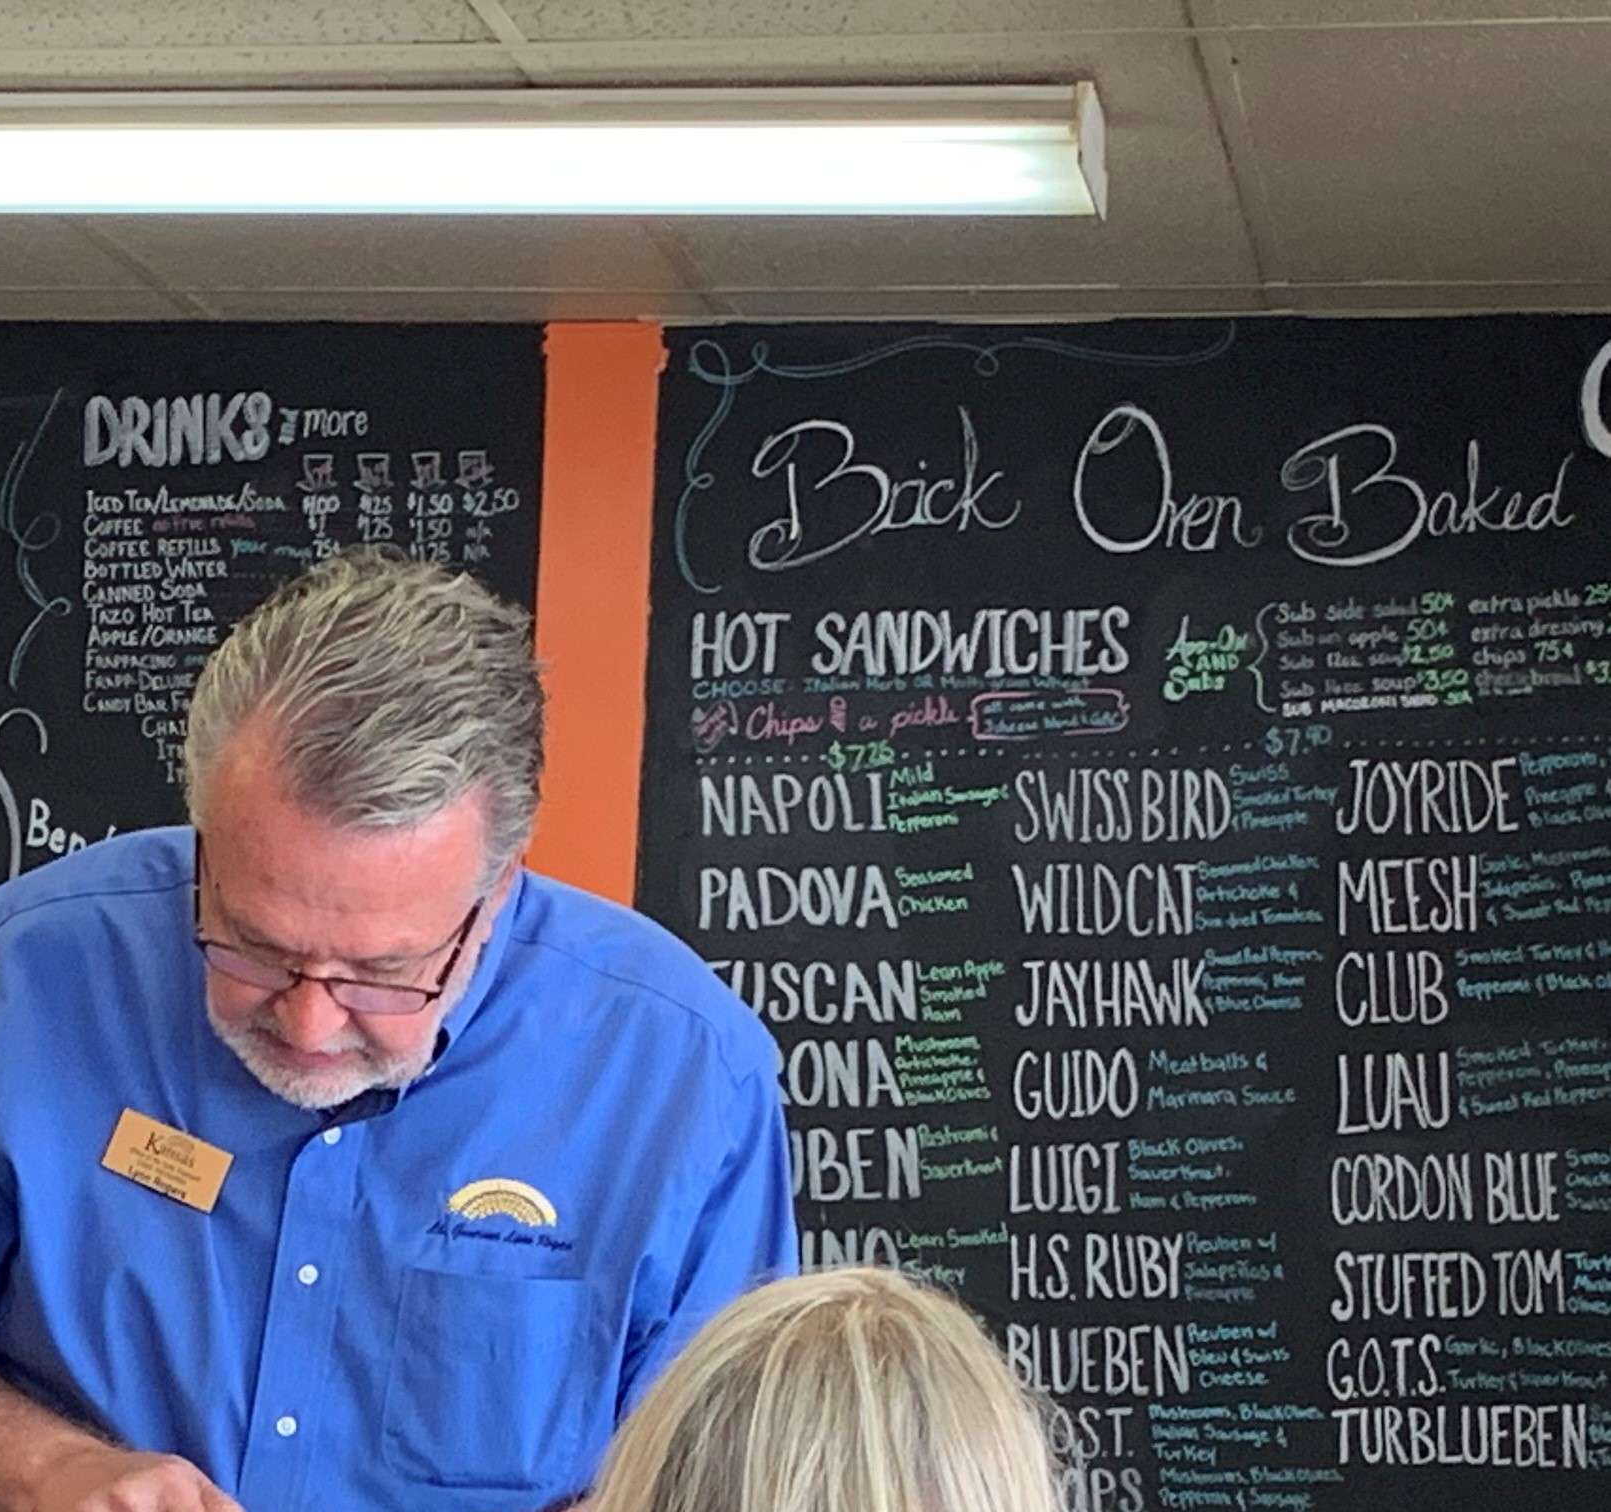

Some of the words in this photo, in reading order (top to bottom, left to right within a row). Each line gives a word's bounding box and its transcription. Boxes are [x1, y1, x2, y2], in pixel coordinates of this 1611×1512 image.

[84, 391, 272, 468] DRINKS
[303, 408, 368, 438] more
[86, 489, 124, 513] ICED
[749, 406, 1021, 570] Brick
[1074, 402, 1263, 554] Oven
[1280, 424, 1576, 567] Baked
[83, 514, 143, 536] COFFEE
[84, 537, 150, 558] COFFEE
[158, 538, 221, 557] REFILLS
[83, 581, 154, 602] CANNED
[160, 577, 207, 600] SODA
[84, 560, 162, 579] BOTTLED
[165, 557, 228, 578] WATER
[87, 603, 134, 624] TAZO
[142, 602, 175, 623] HOT
[179, 601, 214, 622] TEA
[1276, 601, 1316, 623] Sub
[1326, 599, 1364, 621] side
[1471, 623, 1524, 643] extra
[690, 611, 790, 679] HOT
[811, 606, 1129, 677] SANDWICHES
[1277, 629, 1315, 648] Sub
[1279, 655, 1315, 671] Sub
[1281, 681, 1315, 699] Sub
[1371, 676, 1416, 693] soup
[746, 703, 823, 742] Chips
[890, 696, 959, 736] pickle
[890, 761, 934, 789] Mild
[1230, 762, 1289, 786] Swiss
[1336, 758, 1518, 834] JOYRIDE
[701, 773, 887, 836] NAPOLI
[699, 865, 899, 931] PADOVA
[898, 895, 969, 917] Chicken
[1012, 863, 1198, 937] WILDCAT
[1339, 856, 1477, 935] MEESH
[712, 959, 919, 1025] USCAN
[916, 960, 962, 982] Lean
[1015, 959, 1208, 1027] JAYHAWK
[1335, 950, 1448, 1026] CLUB
[1013, 1047, 1138, 1121] GUIDO
[1149, 1050, 1249, 1075] Meatballs
[1337, 1051, 1449, 1134] LUAU
[1128, 1138, 1181, 1161] Black
[1009, 1141, 1122, 1217] LUIGI
[1331, 1153, 1474, 1226] CORDON
[1484, 1152, 1560, 1225] BLUE
[895, 1229, 944, 1248] Lean
[1011, 1232, 1077, 1301] H.S.
[1085, 1232, 1183, 1300] RUBY
[1331, 1249, 1487, 1322] STUFFED
[1492, 1248, 1566, 1317] TOM
[1187, 1323, 1253, 1343] Reuben
[1006, 1323, 1190, 1397] BLUEBEN
[1328, 1333, 1447, 1401] G.O.T.S.
[1152, 1443, 1217, 1465] Turkey
[1333, 1404, 1588, 1470] TURBLUEBEN
